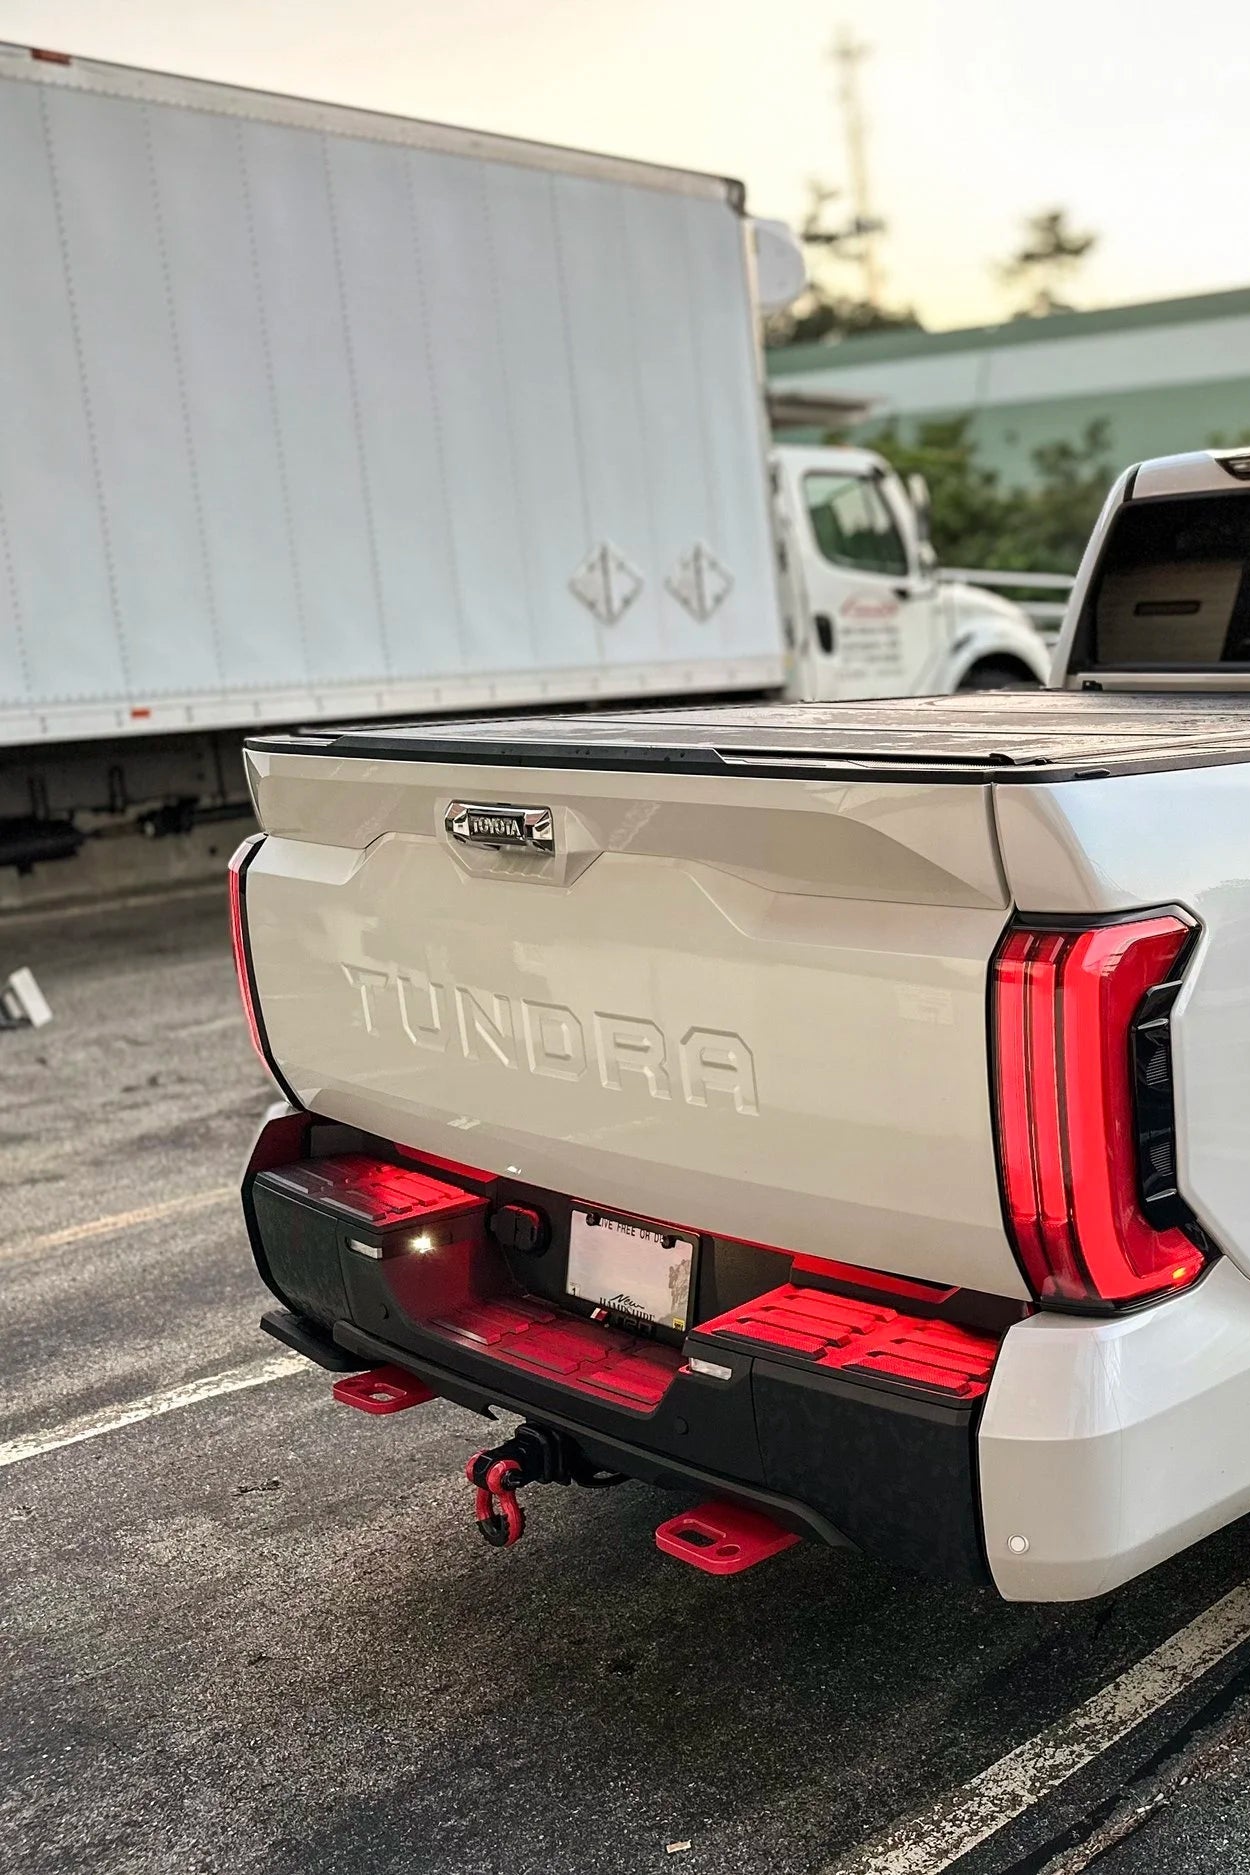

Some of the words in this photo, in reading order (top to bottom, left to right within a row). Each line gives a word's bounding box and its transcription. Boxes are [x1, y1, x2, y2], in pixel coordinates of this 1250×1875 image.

[472, 816, 522, 837] TOYOTA
[341, 962, 760, 1117] TUNDRA
[598, 1218, 614, 1231] IVE
[616, 1224, 636, 1237] FREE
[639, 1230, 651, 1241] OR
[609, 1293, 646, 1310] New
